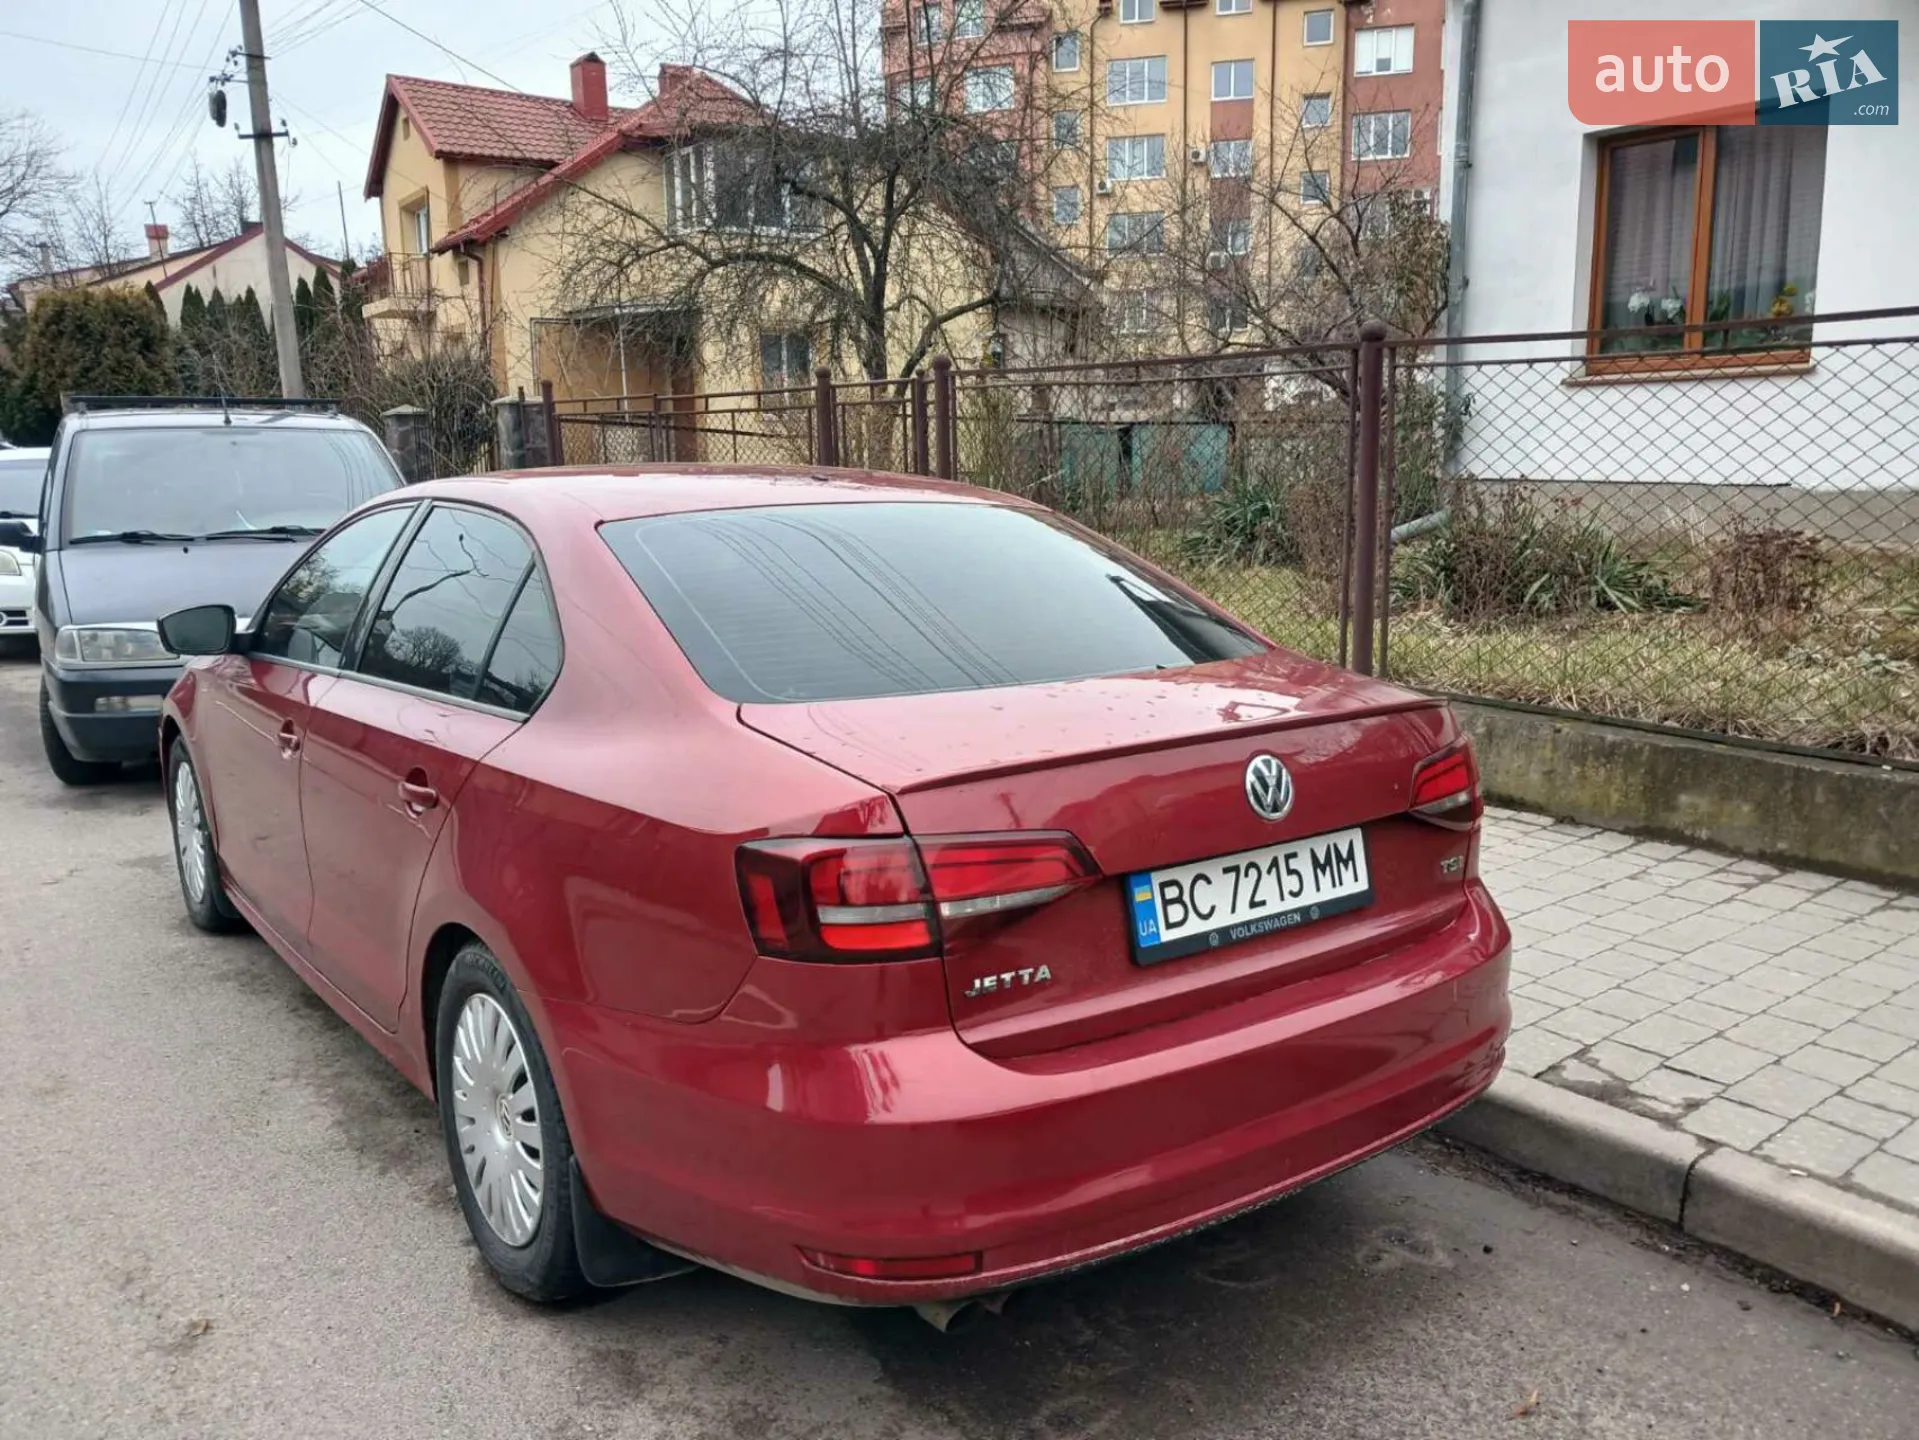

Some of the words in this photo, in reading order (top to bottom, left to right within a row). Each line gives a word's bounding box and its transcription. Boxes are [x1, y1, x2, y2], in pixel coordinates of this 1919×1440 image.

[1158, 872, 1216, 931] BC
[1222, 851, 1304, 915] 7215
[1310, 838, 1359, 893] MM
[1138, 918, 1158, 937] UA
[1229, 911, 1302, 940] VOLKSWAGEN
[964, 964, 1052, 998] JETTA
